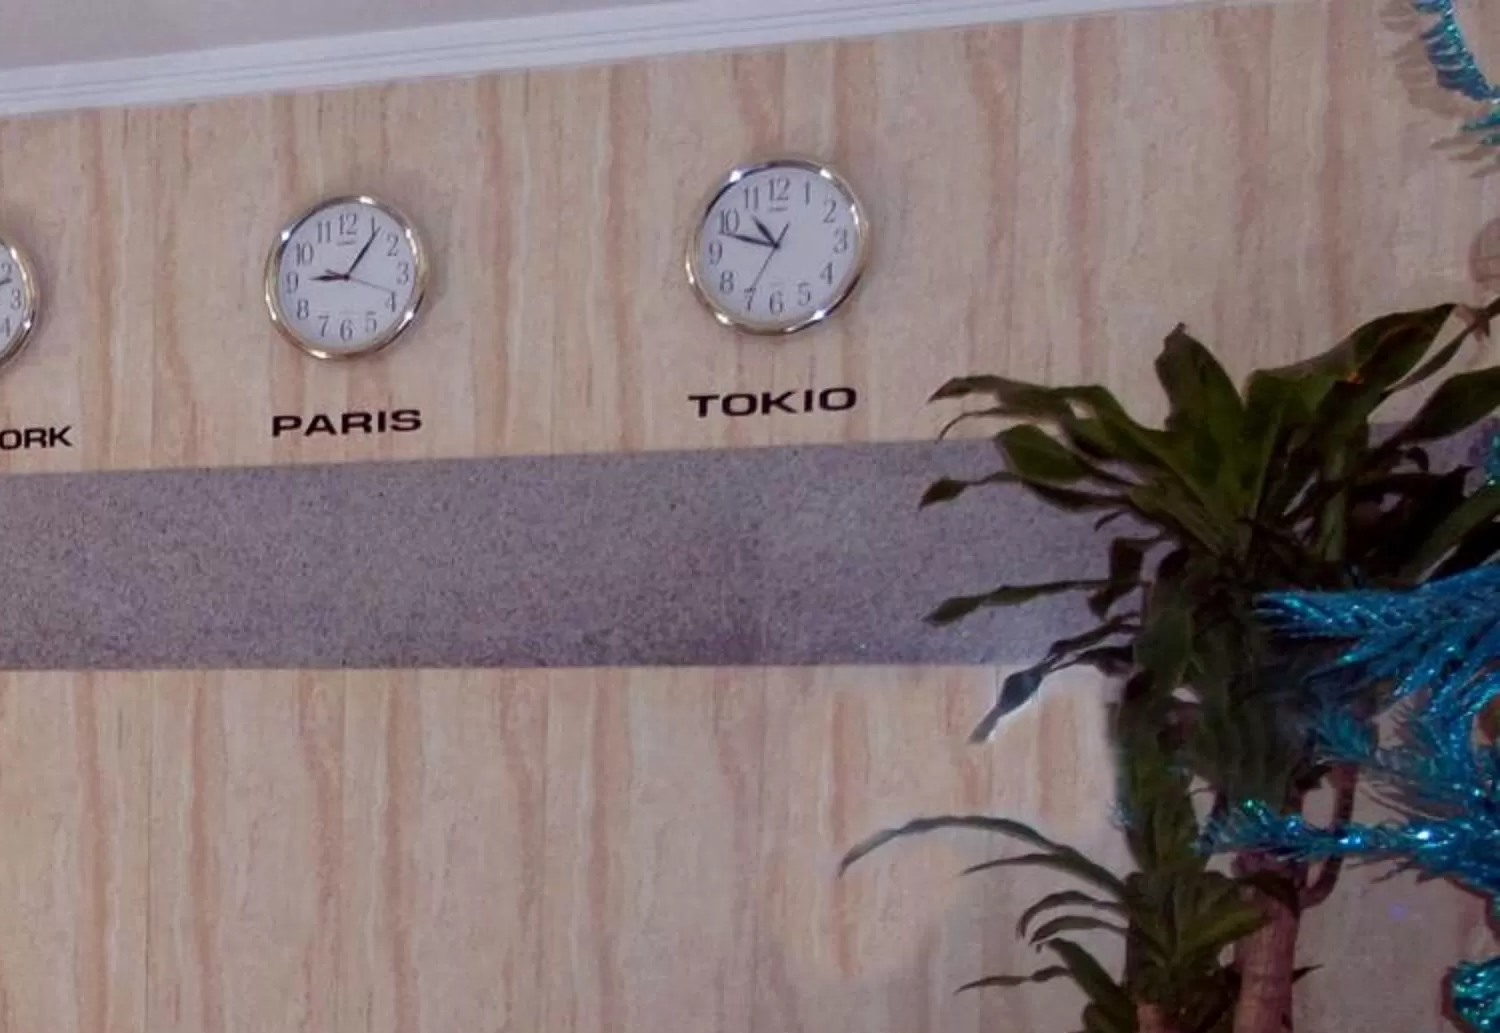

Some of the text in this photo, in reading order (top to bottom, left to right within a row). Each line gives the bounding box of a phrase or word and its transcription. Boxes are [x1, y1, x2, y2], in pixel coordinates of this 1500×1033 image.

[743, 187, 760, 209] 11
[768, 178, 789, 201] 12
[803, 182, 811, 205] 1
[720, 210, 740, 233] 10
[823, 200, 837, 223] 2
[317, 222, 332, 243] 11
[339, 213, 358, 235] 12
[386, 234, 399, 257] 2
[833, 229, 848, 253] 3
[295, 243, 314, 265] 10
[709, 241, 722, 264] 9
[1, 262, 13, 280] 2
[396, 262, 409, 285] 3
[820, 262, 833, 285] 4
[286, 273, 299, 294] 9
[720, 272, 734, 294] 8
[797, 283, 811, 305] 5
[10, 289, 21, 309] 3
[297, 299, 309, 320] 8
[385, 291, 396, 313] 4
[744, 288, 755, 312] 7
[769, 291, 784, 315] 6
[318, 315, 330, 337] 7
[340, 320, 353, 342] 6
[365, 312, 377, 333] 5
[688, 387, 857, 418] TOKIO
[273, 409, 423, 437] PARIS
